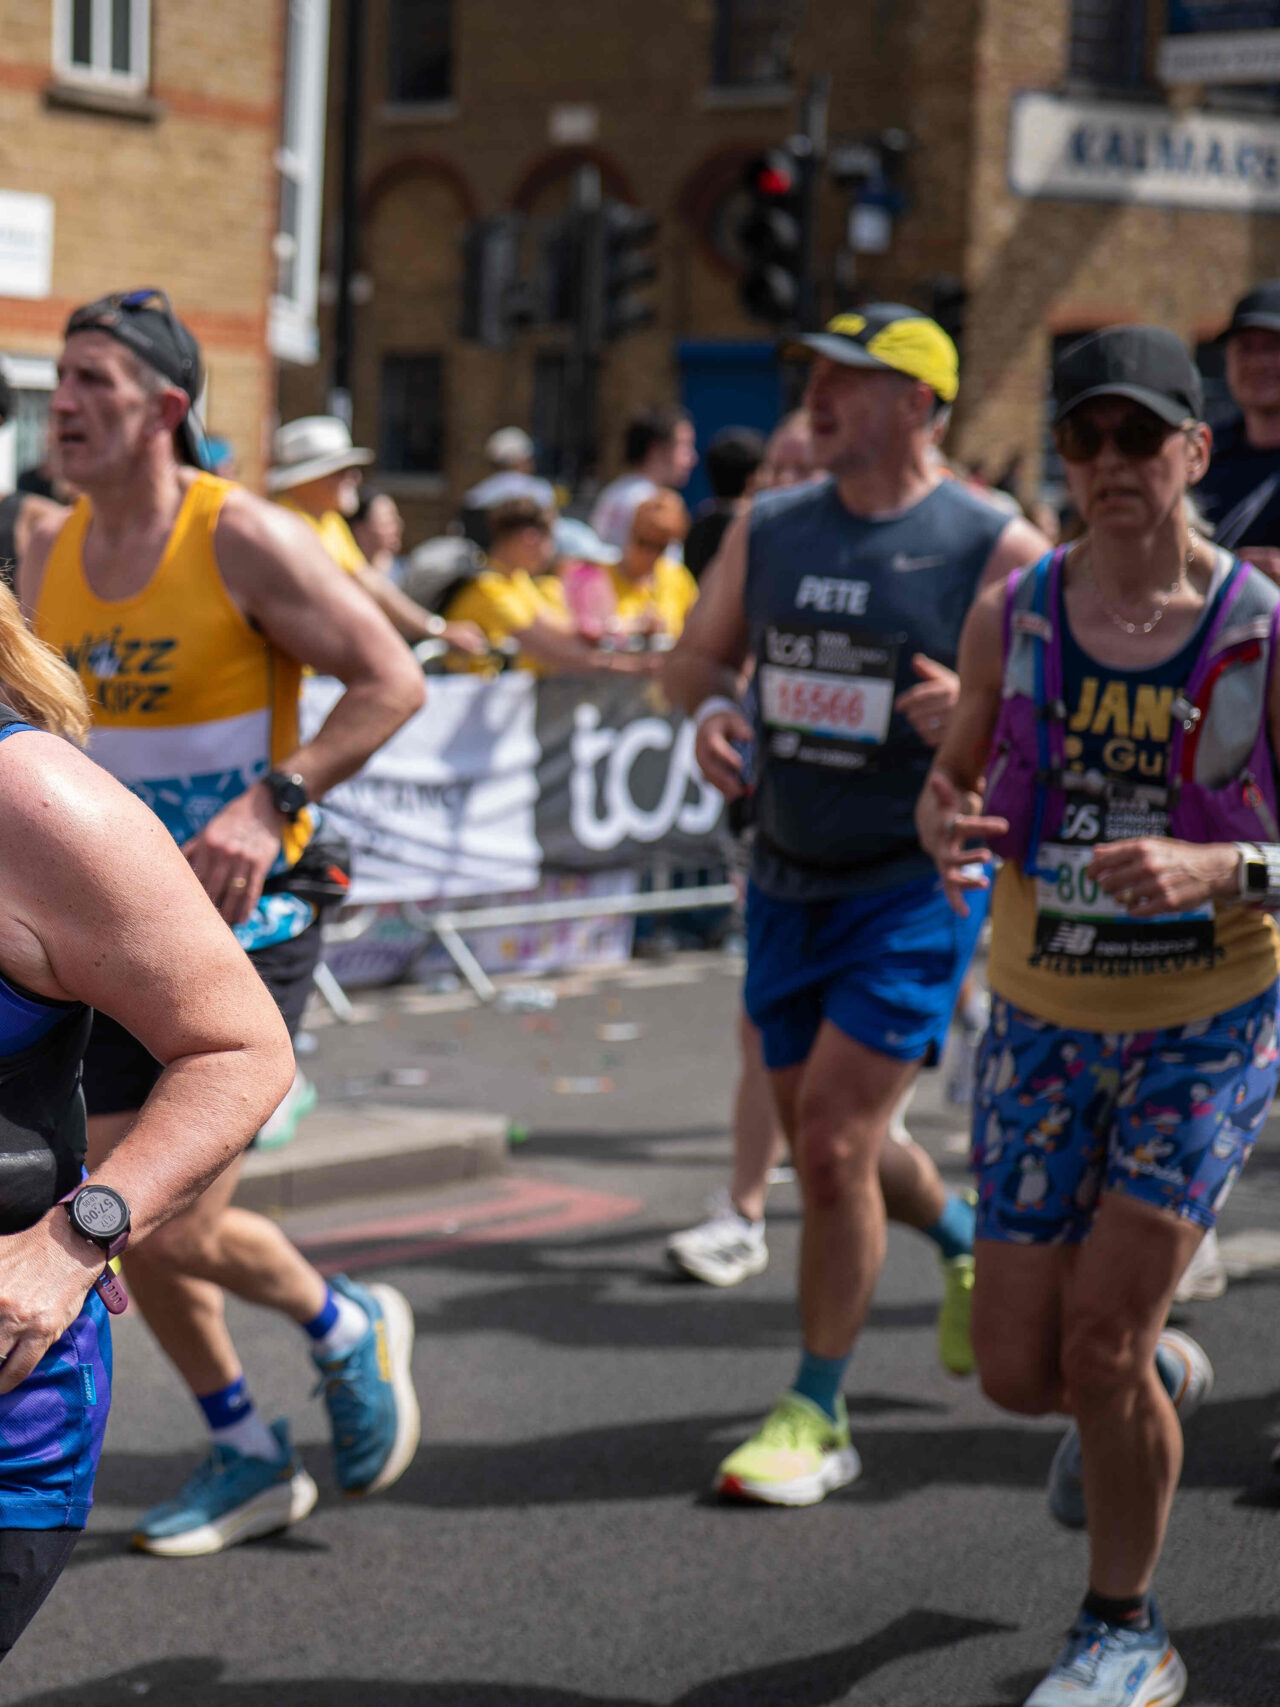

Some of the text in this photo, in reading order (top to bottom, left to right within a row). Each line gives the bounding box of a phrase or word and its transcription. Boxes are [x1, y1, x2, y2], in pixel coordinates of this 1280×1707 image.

[795, 574, 870, 615] PETE
[778, 682, 866, 728] 15566
[1070, 676, 1184, 741] JAN
[570, 703, 723, 851] tcs
[1102, 738, 1175, 777] Gu
